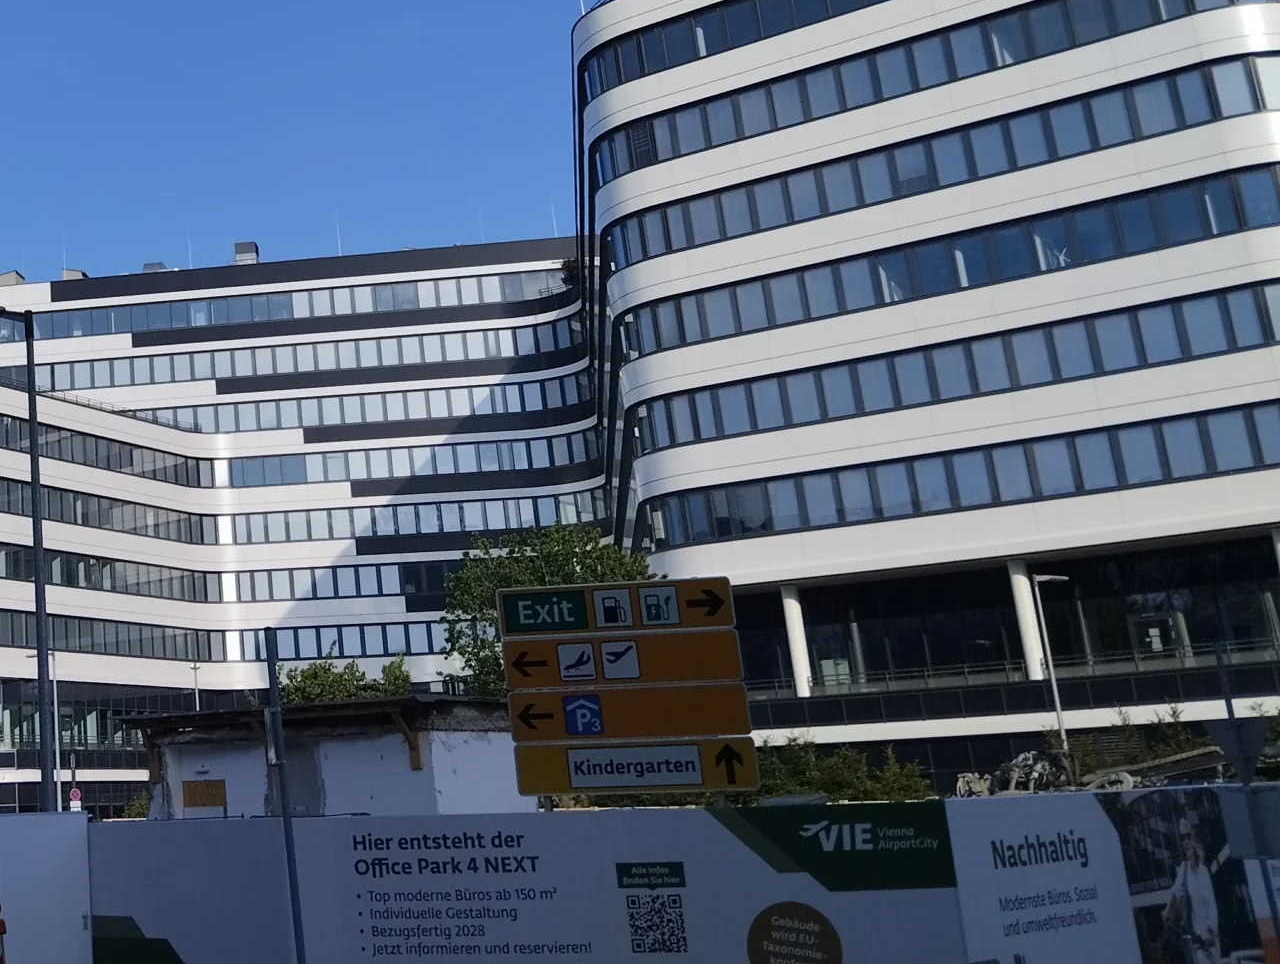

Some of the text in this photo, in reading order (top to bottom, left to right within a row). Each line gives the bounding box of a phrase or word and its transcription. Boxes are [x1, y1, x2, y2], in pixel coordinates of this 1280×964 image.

[518, 597, 575, 625] Exit
[573, 756, 697, 778] Kindergarten
[352, 831, 524, 851] Hier entsteht der
[819, 823, 915, 852] VIE Vienna
[877, 836, 939, 852] AirportCity
[990, 829, 1089, 870] Nachhaltig
[354, 856, 539, 878] Office Park 4 NEXT
[631, 866, 669, 875] Alle Infos
[622, 875, 680, 886] finden Sie hier
[367, 886, 557, 905] Top moderne Büros ab 150 m²
[998, 894, 1047, 913] Modernste
[1073, 884, 1098, 903] Sozial
[369, 906, 518, 922] Individuelle Gestaltung
[771, 915, 821, 932] Gebäude
[371, 924, 486, 940] Bezugsfertig 2028
[1002, 918, 1021, 937] und
[770, 930, 820, 945] wird EU-
[372, 940, 592, 957] Jetzt informieren und reservieren!
[761, 940, 829, 960] Taxonomie-
